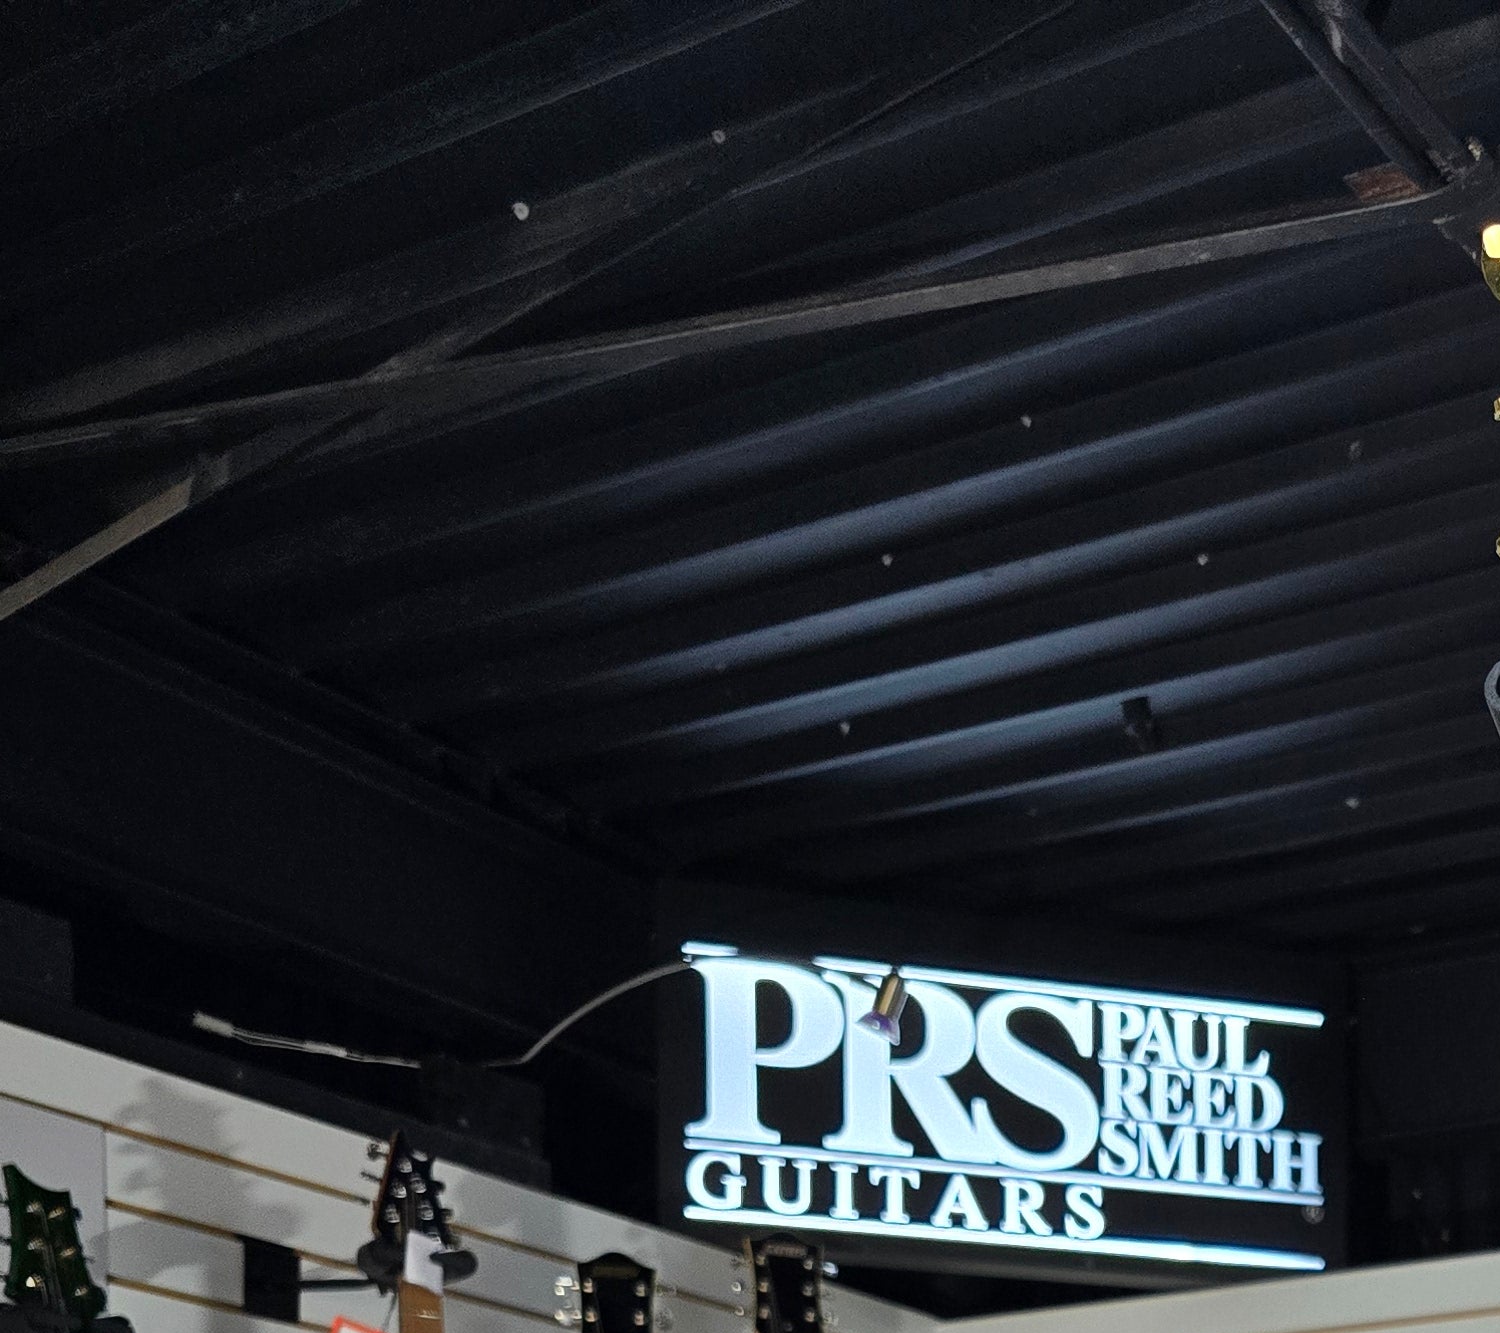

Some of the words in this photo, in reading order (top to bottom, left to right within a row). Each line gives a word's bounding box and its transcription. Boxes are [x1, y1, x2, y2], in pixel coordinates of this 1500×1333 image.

[684, 956, 1100, 1171] PRS
[1097, 1001, 1271, 1077] PAUL
[1097, 1061, 1285, 1133] REED
[1097, 1118, 1324, 1195] SMITH
[685, 1152, 1106, 1241] GUITARS
